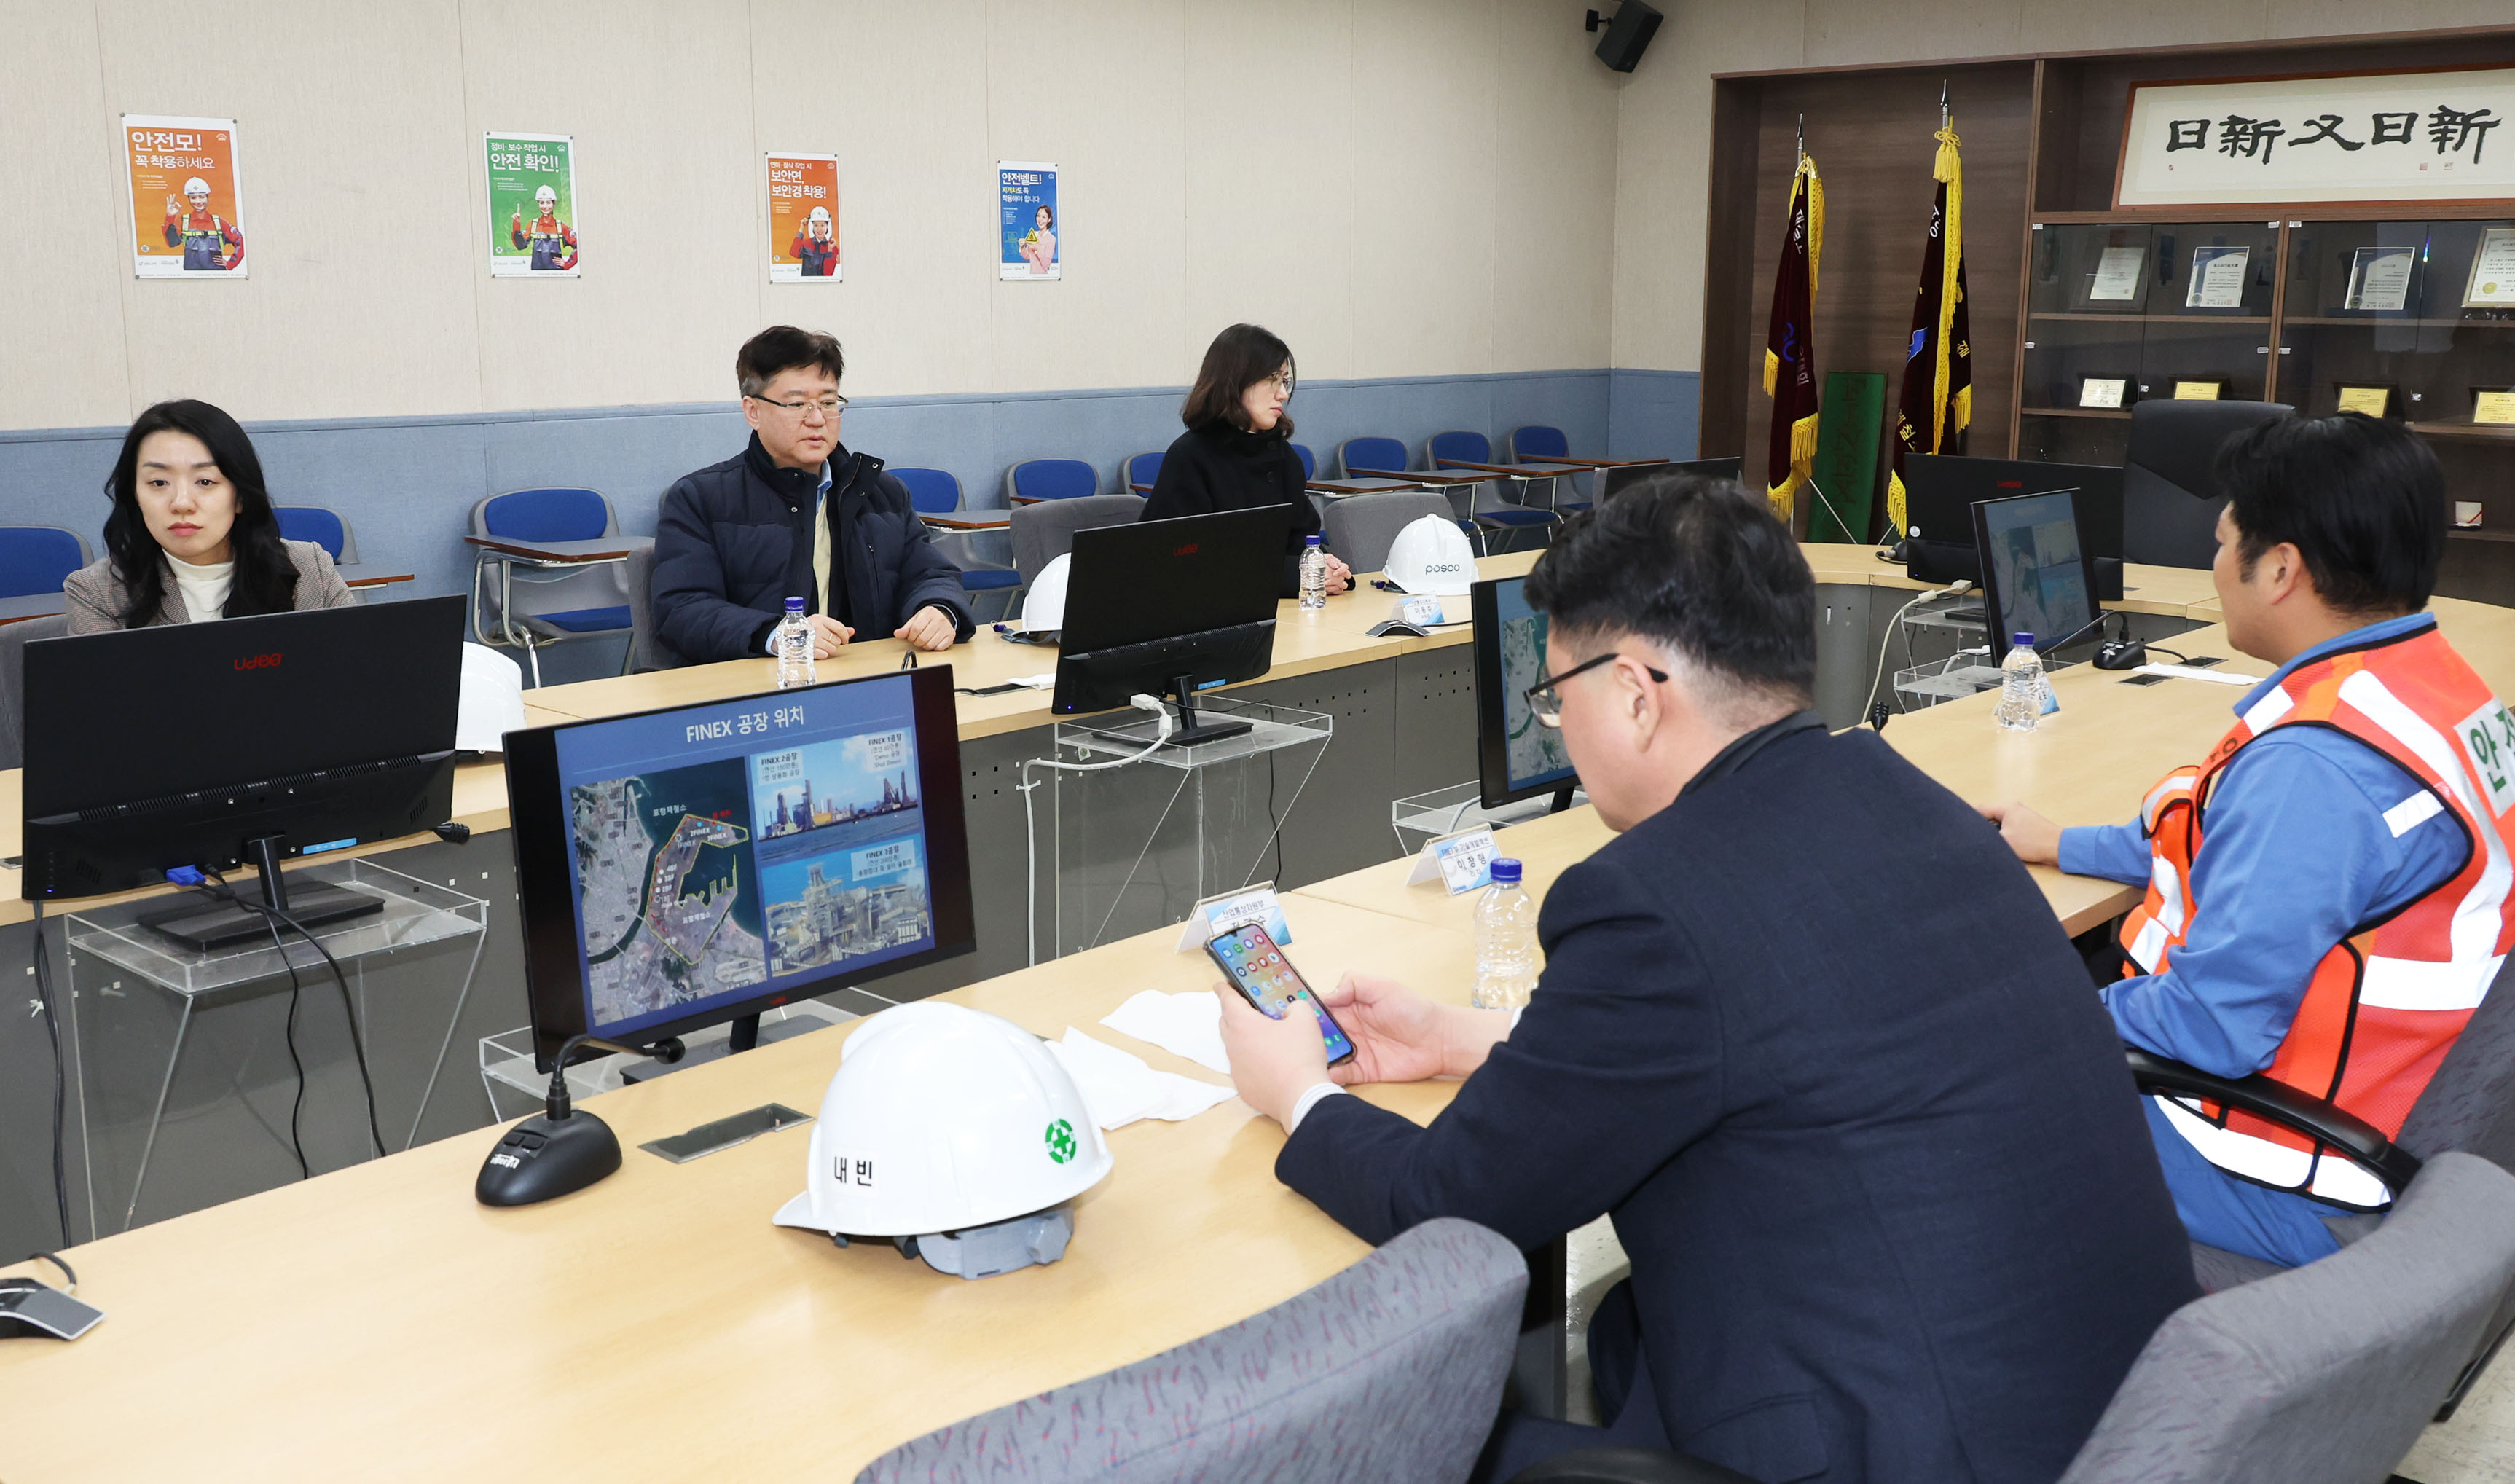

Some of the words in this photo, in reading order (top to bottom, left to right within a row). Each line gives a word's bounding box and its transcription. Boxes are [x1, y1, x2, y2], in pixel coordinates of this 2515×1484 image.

[131, 131, 202, 152] 안전모!
[523, 144, 538, 152] 작업
[538, 144, 546, 153] 시
[135, 154, 149, 168] 꼭
[150, 155, 216, 170] 착용하세요
[491, 153, 522, 170] 안전
[524, 153, 560, 173] 확인!
[771, 170, 804, 184] 보안면,
[1002, 172, 1042, 185] 안전벨트!
[771, 185, 802, 198] 보안경
[803, 185, 827, 199] 착용!
[1425, 564, 1460, 576] posco
[686, 720, 733, 743] FINEX
[737, 712, 769, 734] 공장
[774, 705, 804, 729] 위치
[761, 756, 780, 766] FINEX
